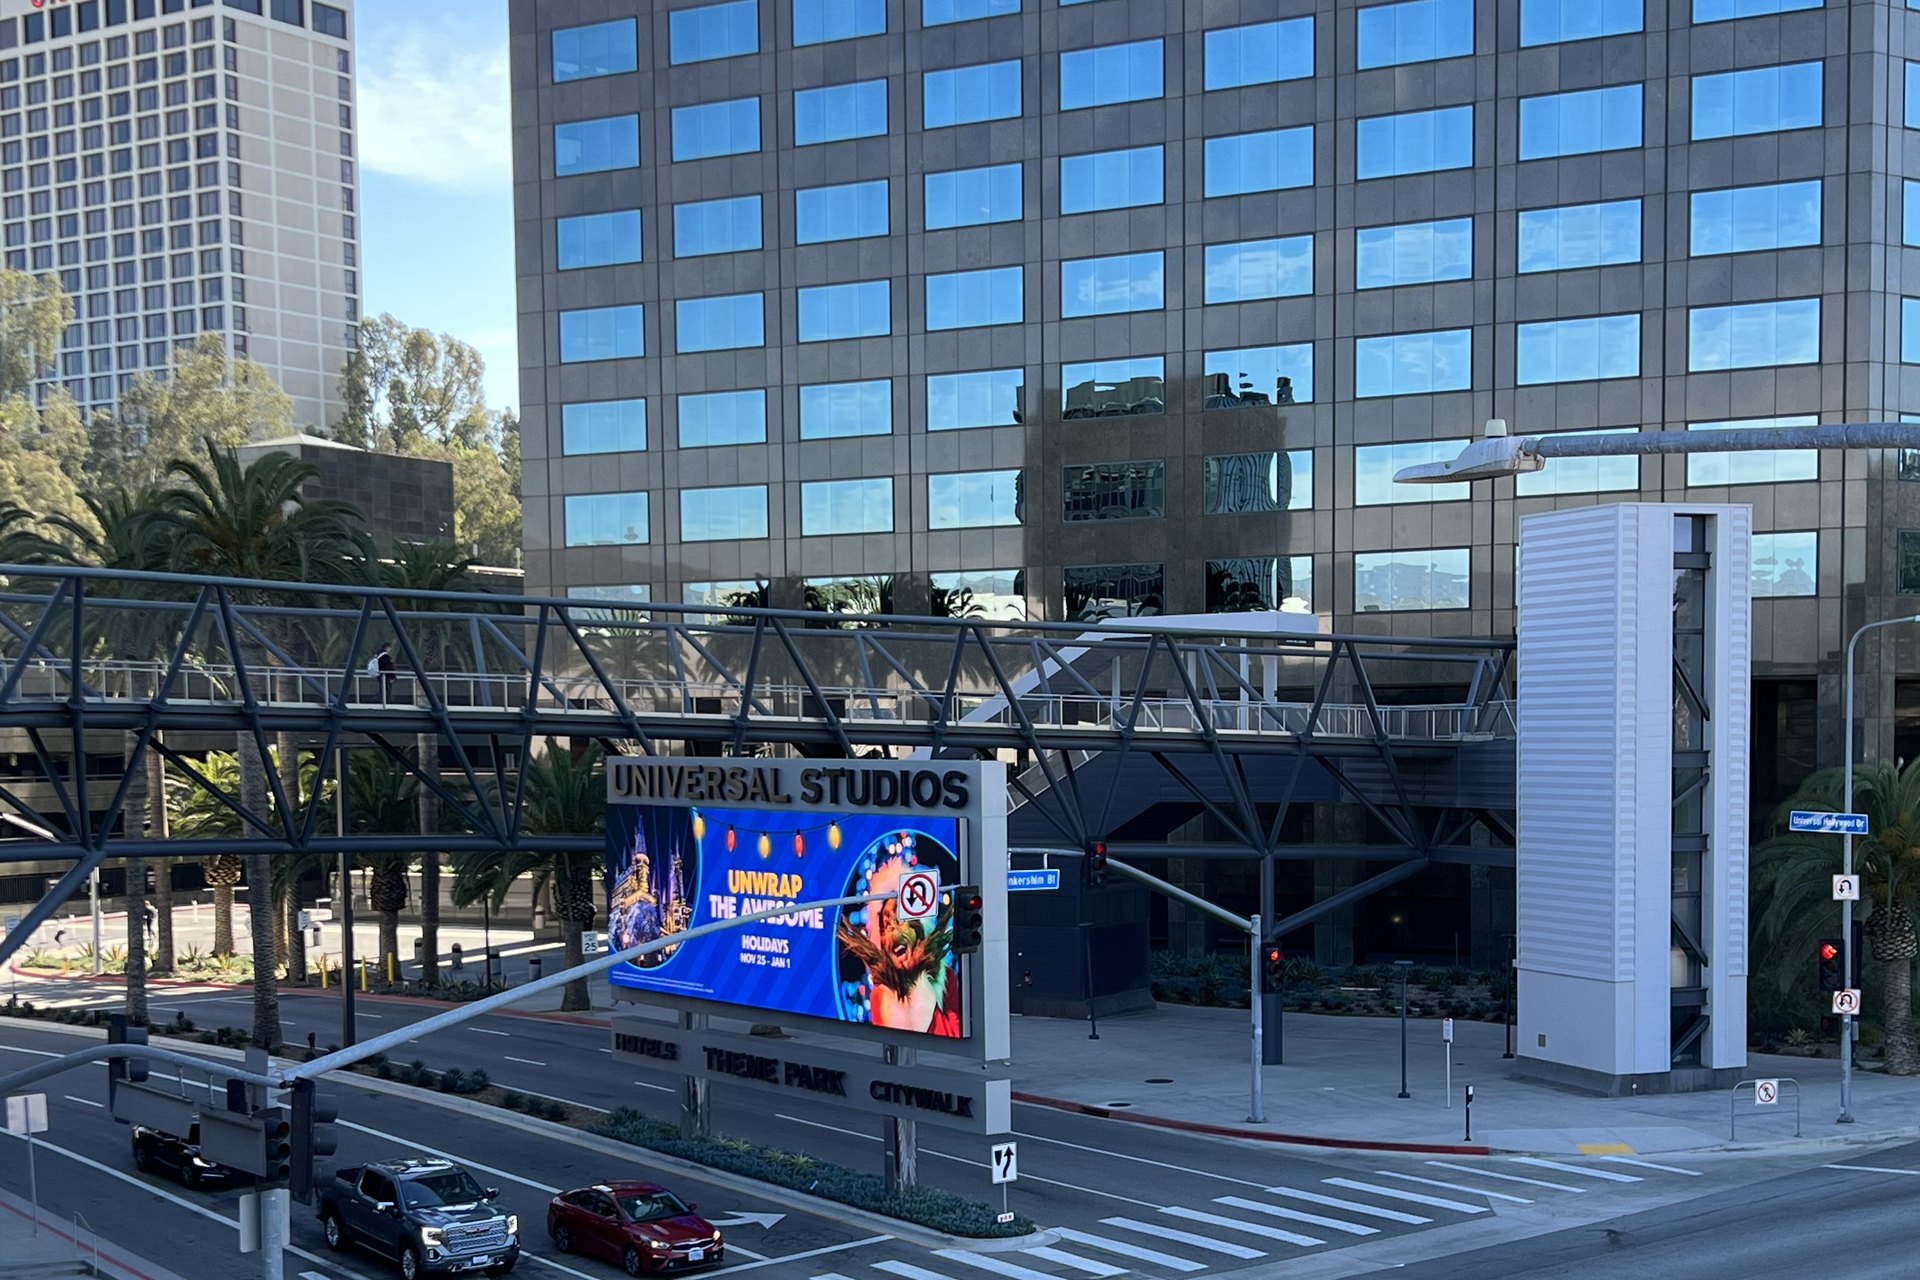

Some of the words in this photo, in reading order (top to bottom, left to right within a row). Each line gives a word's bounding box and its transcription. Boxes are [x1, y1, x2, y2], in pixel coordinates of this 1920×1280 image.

[614, 764, 792, 804] UNIVERSAL
[800, 767, 969, 809] STUDIOS
[728, 869, 803, 898] UNWRAP
[1008, 875, 1045, 886] nkershim
[709, 894, 737, 920] THE
[741, 898, 824, 929] AWESOME
[584, 942, 597, 952] 25
[741, 934, 789, 955] HOLIDAYS
[740, 952, 756, 964] NOV
[757, 954, 766, 966] 25
[771, 957, 785, 968] JAN
[787, 958, 791, 968] 1
[615, 1033, 677, 1060] HOTELS
[703, 1046, 779, 1084] THEME
[784, 1062, 848, 1096] PARK
[870, 1080, 973, 1119] CITYWALK
